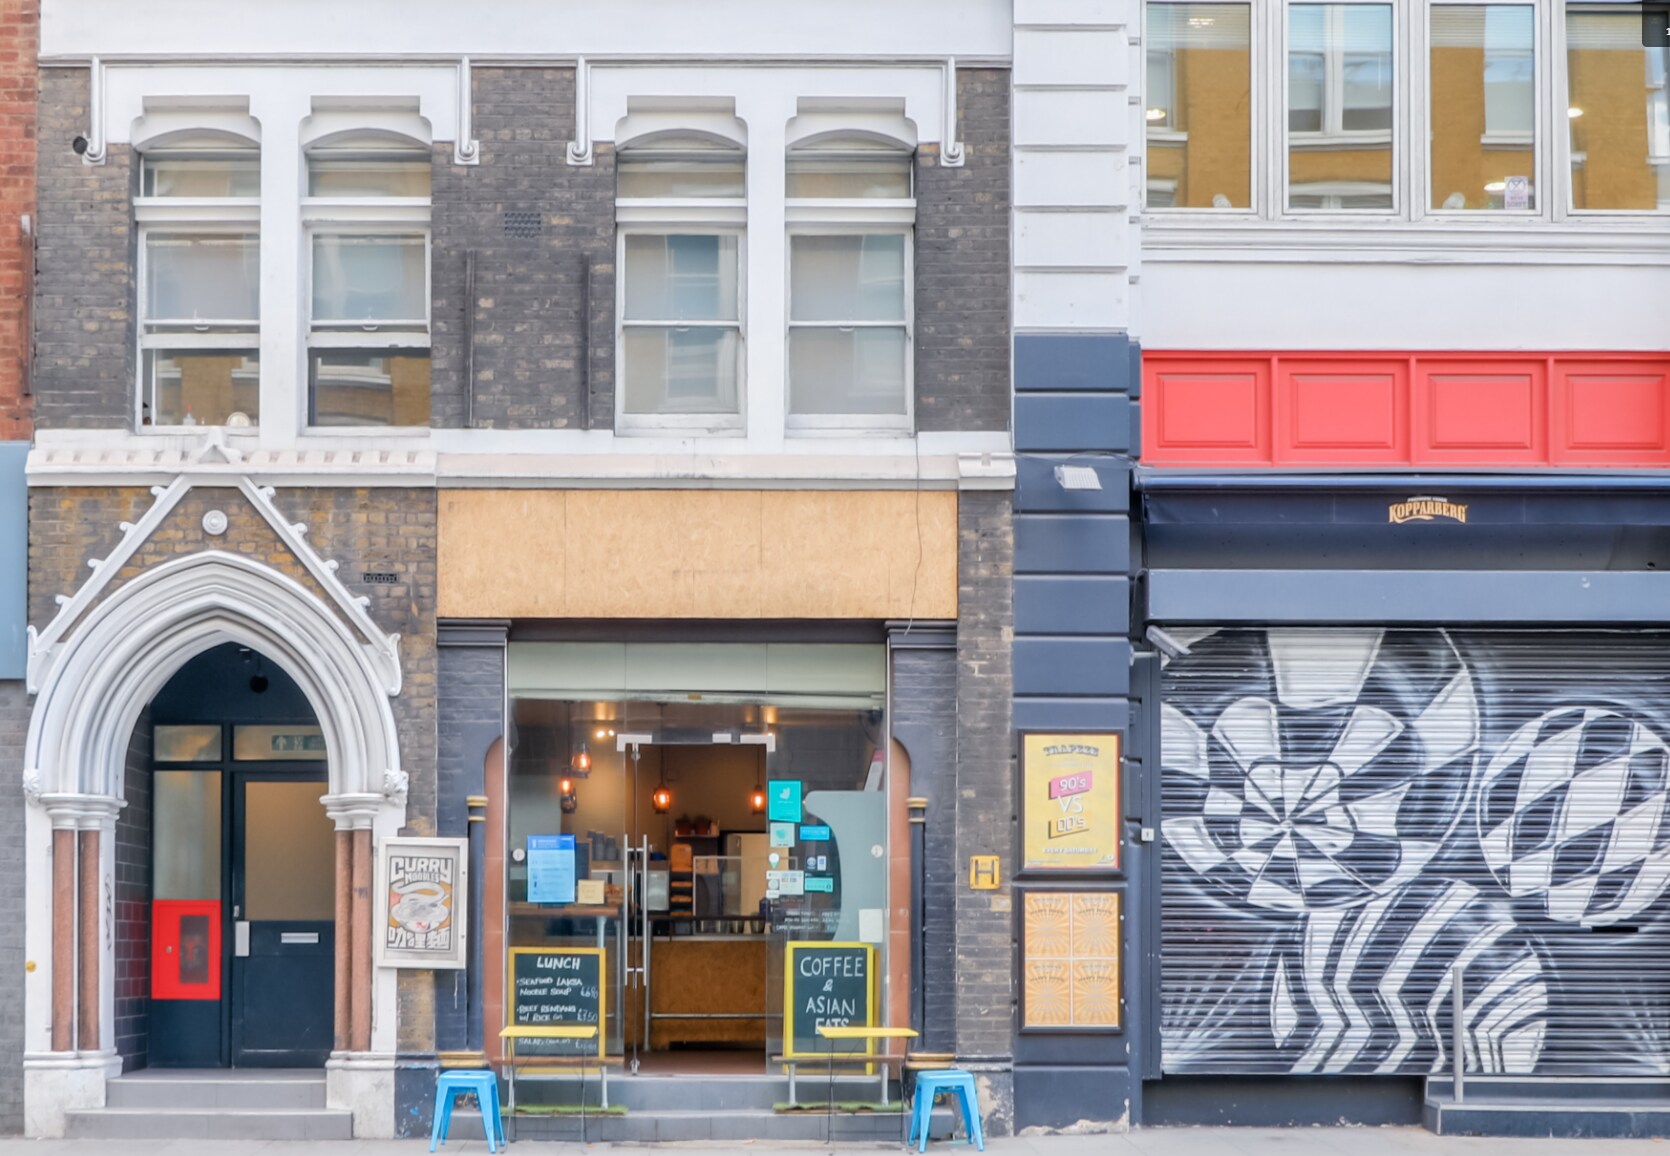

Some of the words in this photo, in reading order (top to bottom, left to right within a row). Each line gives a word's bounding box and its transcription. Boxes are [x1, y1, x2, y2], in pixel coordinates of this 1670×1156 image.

[1389, 501, 1466, 523] KOPPARBERG
[1060, 775, 1086, 791] 90's
[1057, 795, 1083, 813] VS
[390, 857, 453, 882] CURRY
[537, 956, 581, 970] LUNCH
[800, 956, 864, 977] COFFEE
[822, 978, 834, 992] &
[806, 995, 856, 1016] ASIAN
